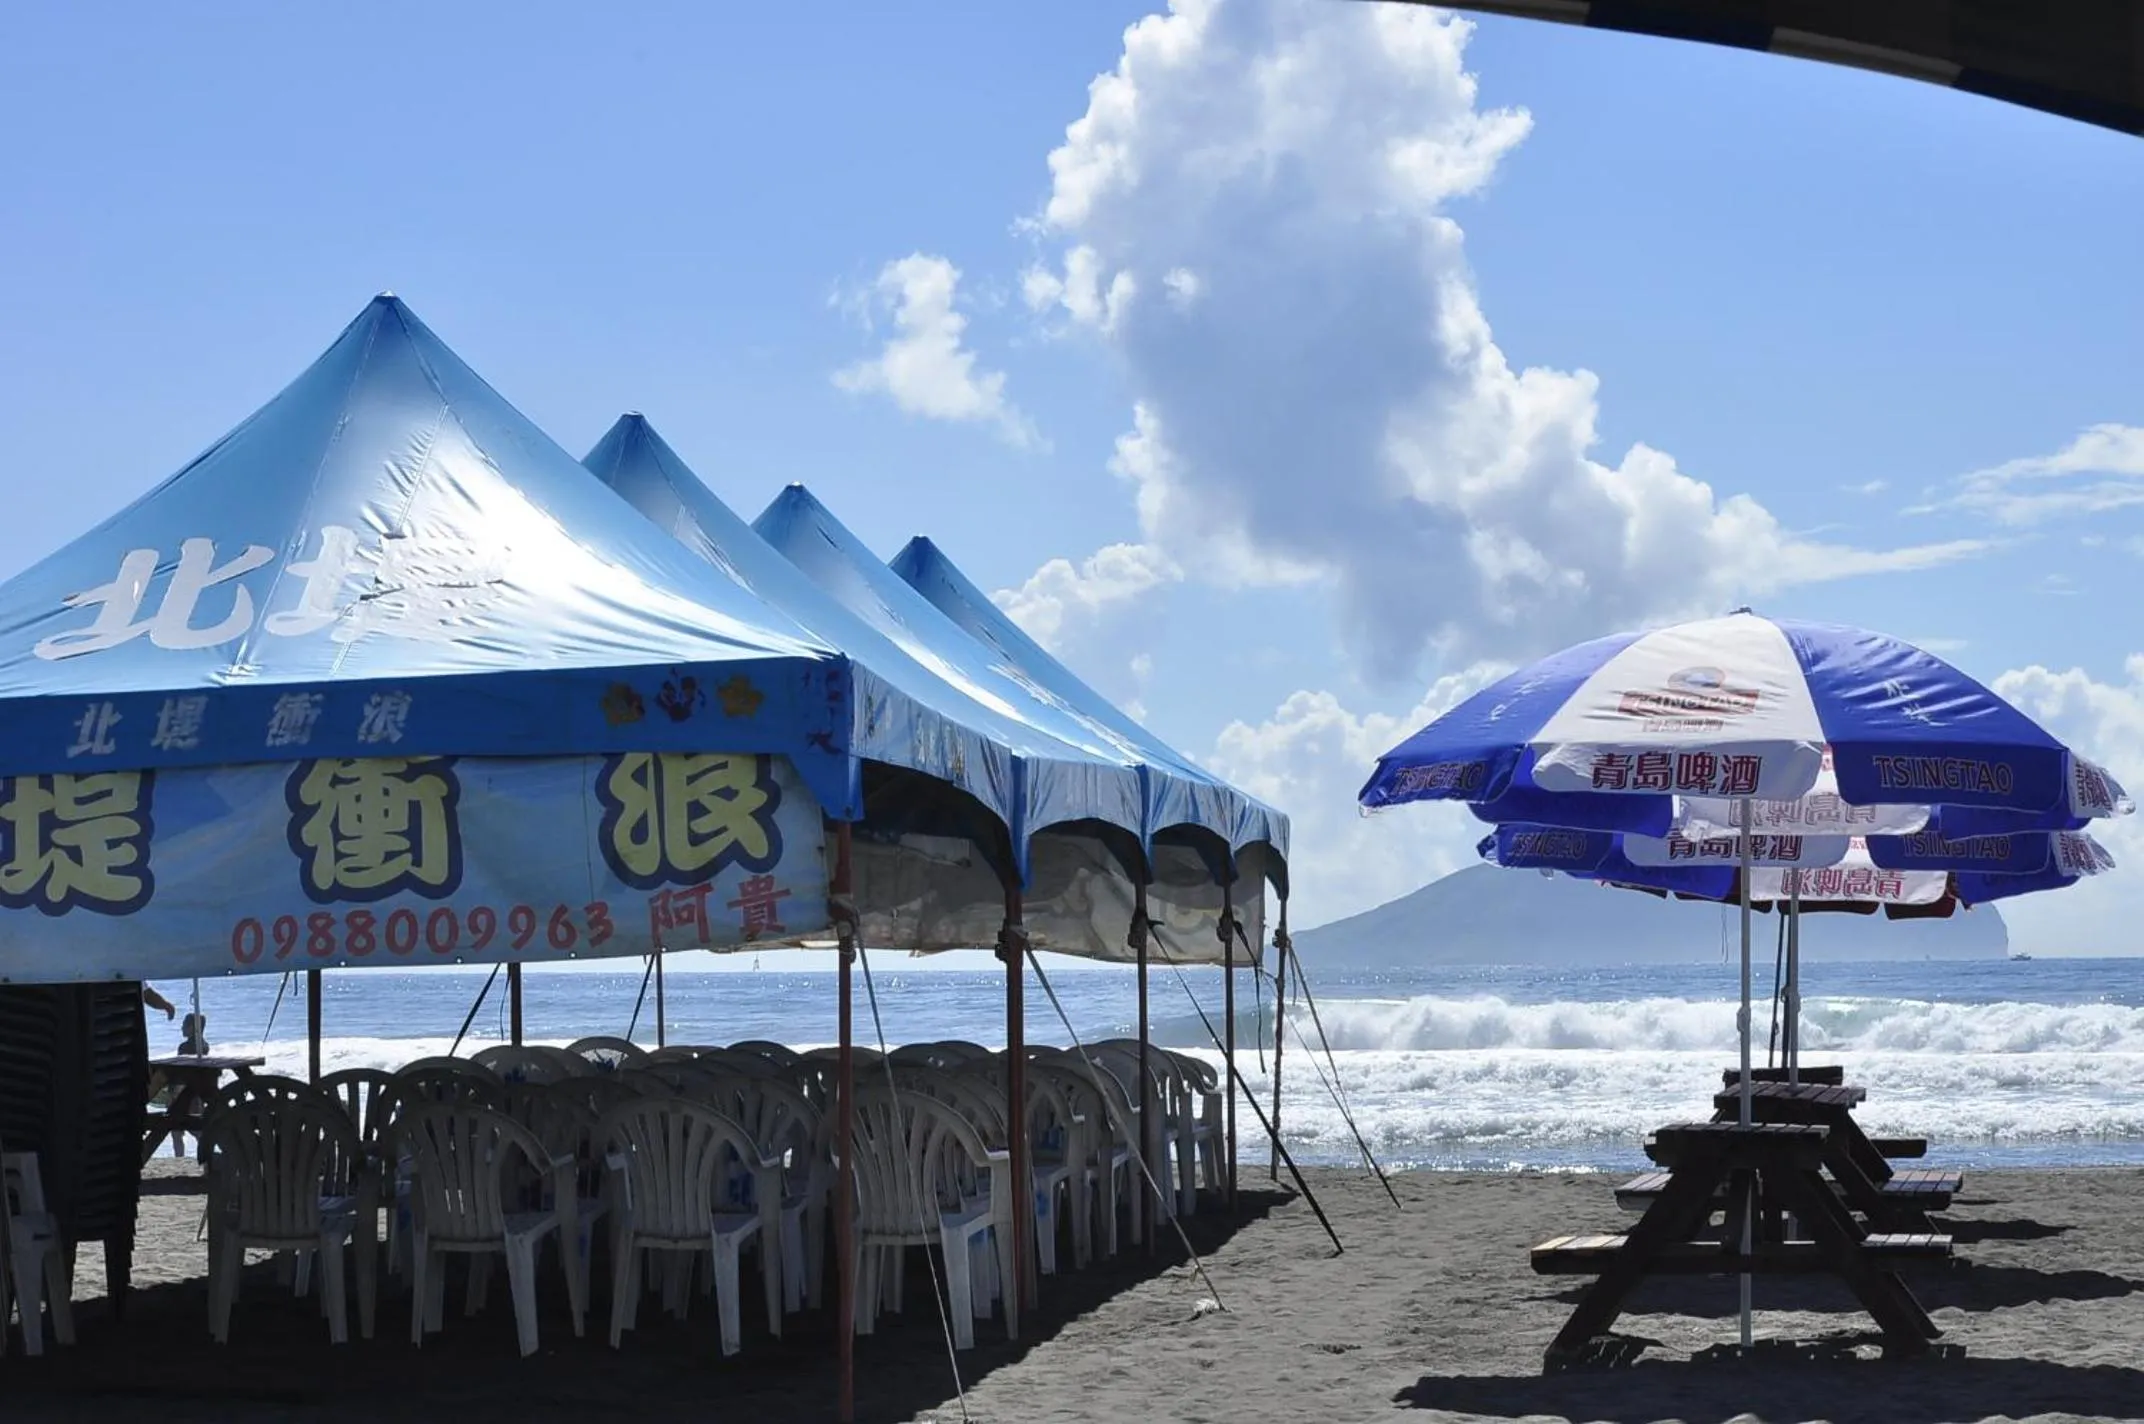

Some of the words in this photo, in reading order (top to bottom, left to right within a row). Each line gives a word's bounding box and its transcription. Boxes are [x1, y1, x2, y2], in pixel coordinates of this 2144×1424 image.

[1589, 750, 1762, 795] 青島啤酒
[1873, 756, 2014, 794] TSINGTAO
[231, 901, 615, 965] 0988009963
[648, 873, 793, 948] 阿貴
